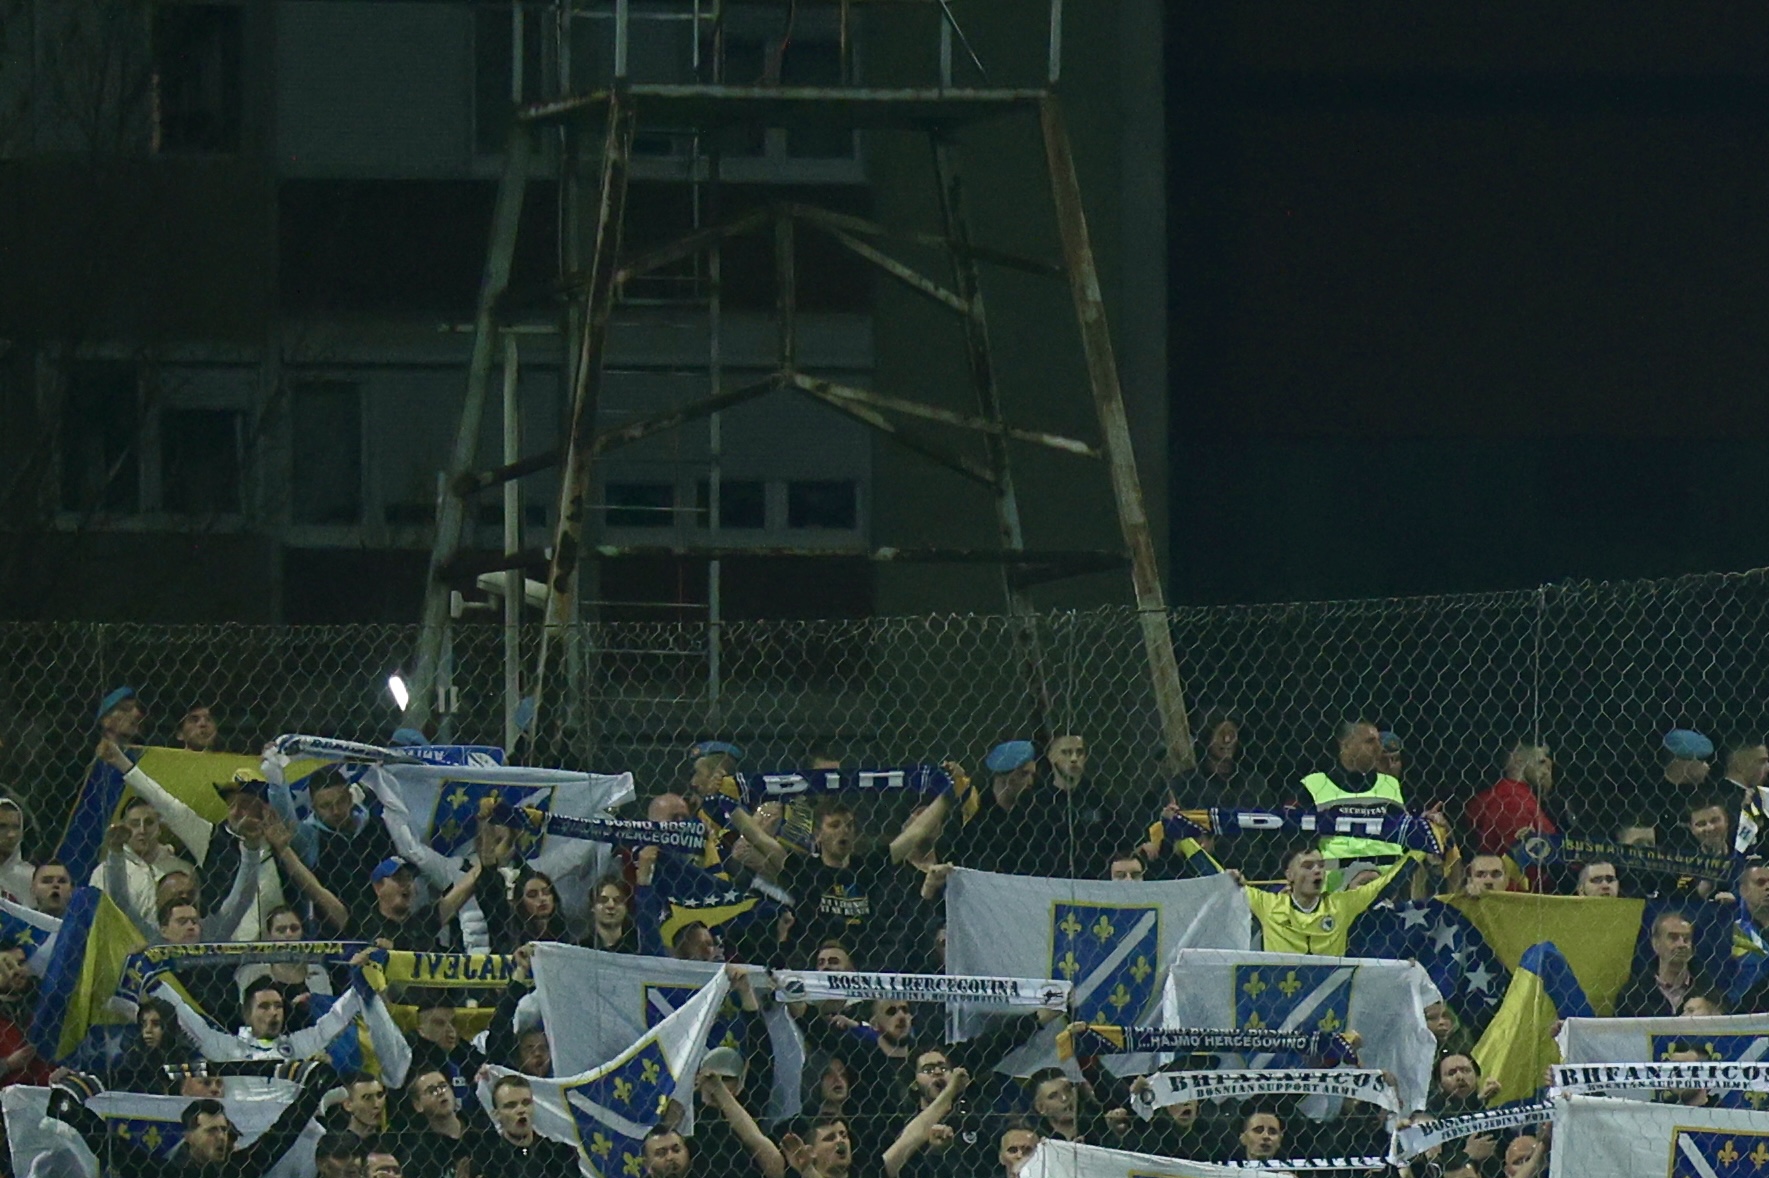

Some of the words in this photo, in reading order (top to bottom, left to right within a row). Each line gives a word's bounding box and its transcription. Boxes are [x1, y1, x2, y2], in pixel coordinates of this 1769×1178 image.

[827, 974, 883, 991] BOSNA
[901, 975, 1021, 998] HERCEGOVINA
[1196, 1083, 1255, 1098] BOSNIAN
[1257, 1081, 1320, 1092] SUPPORT
